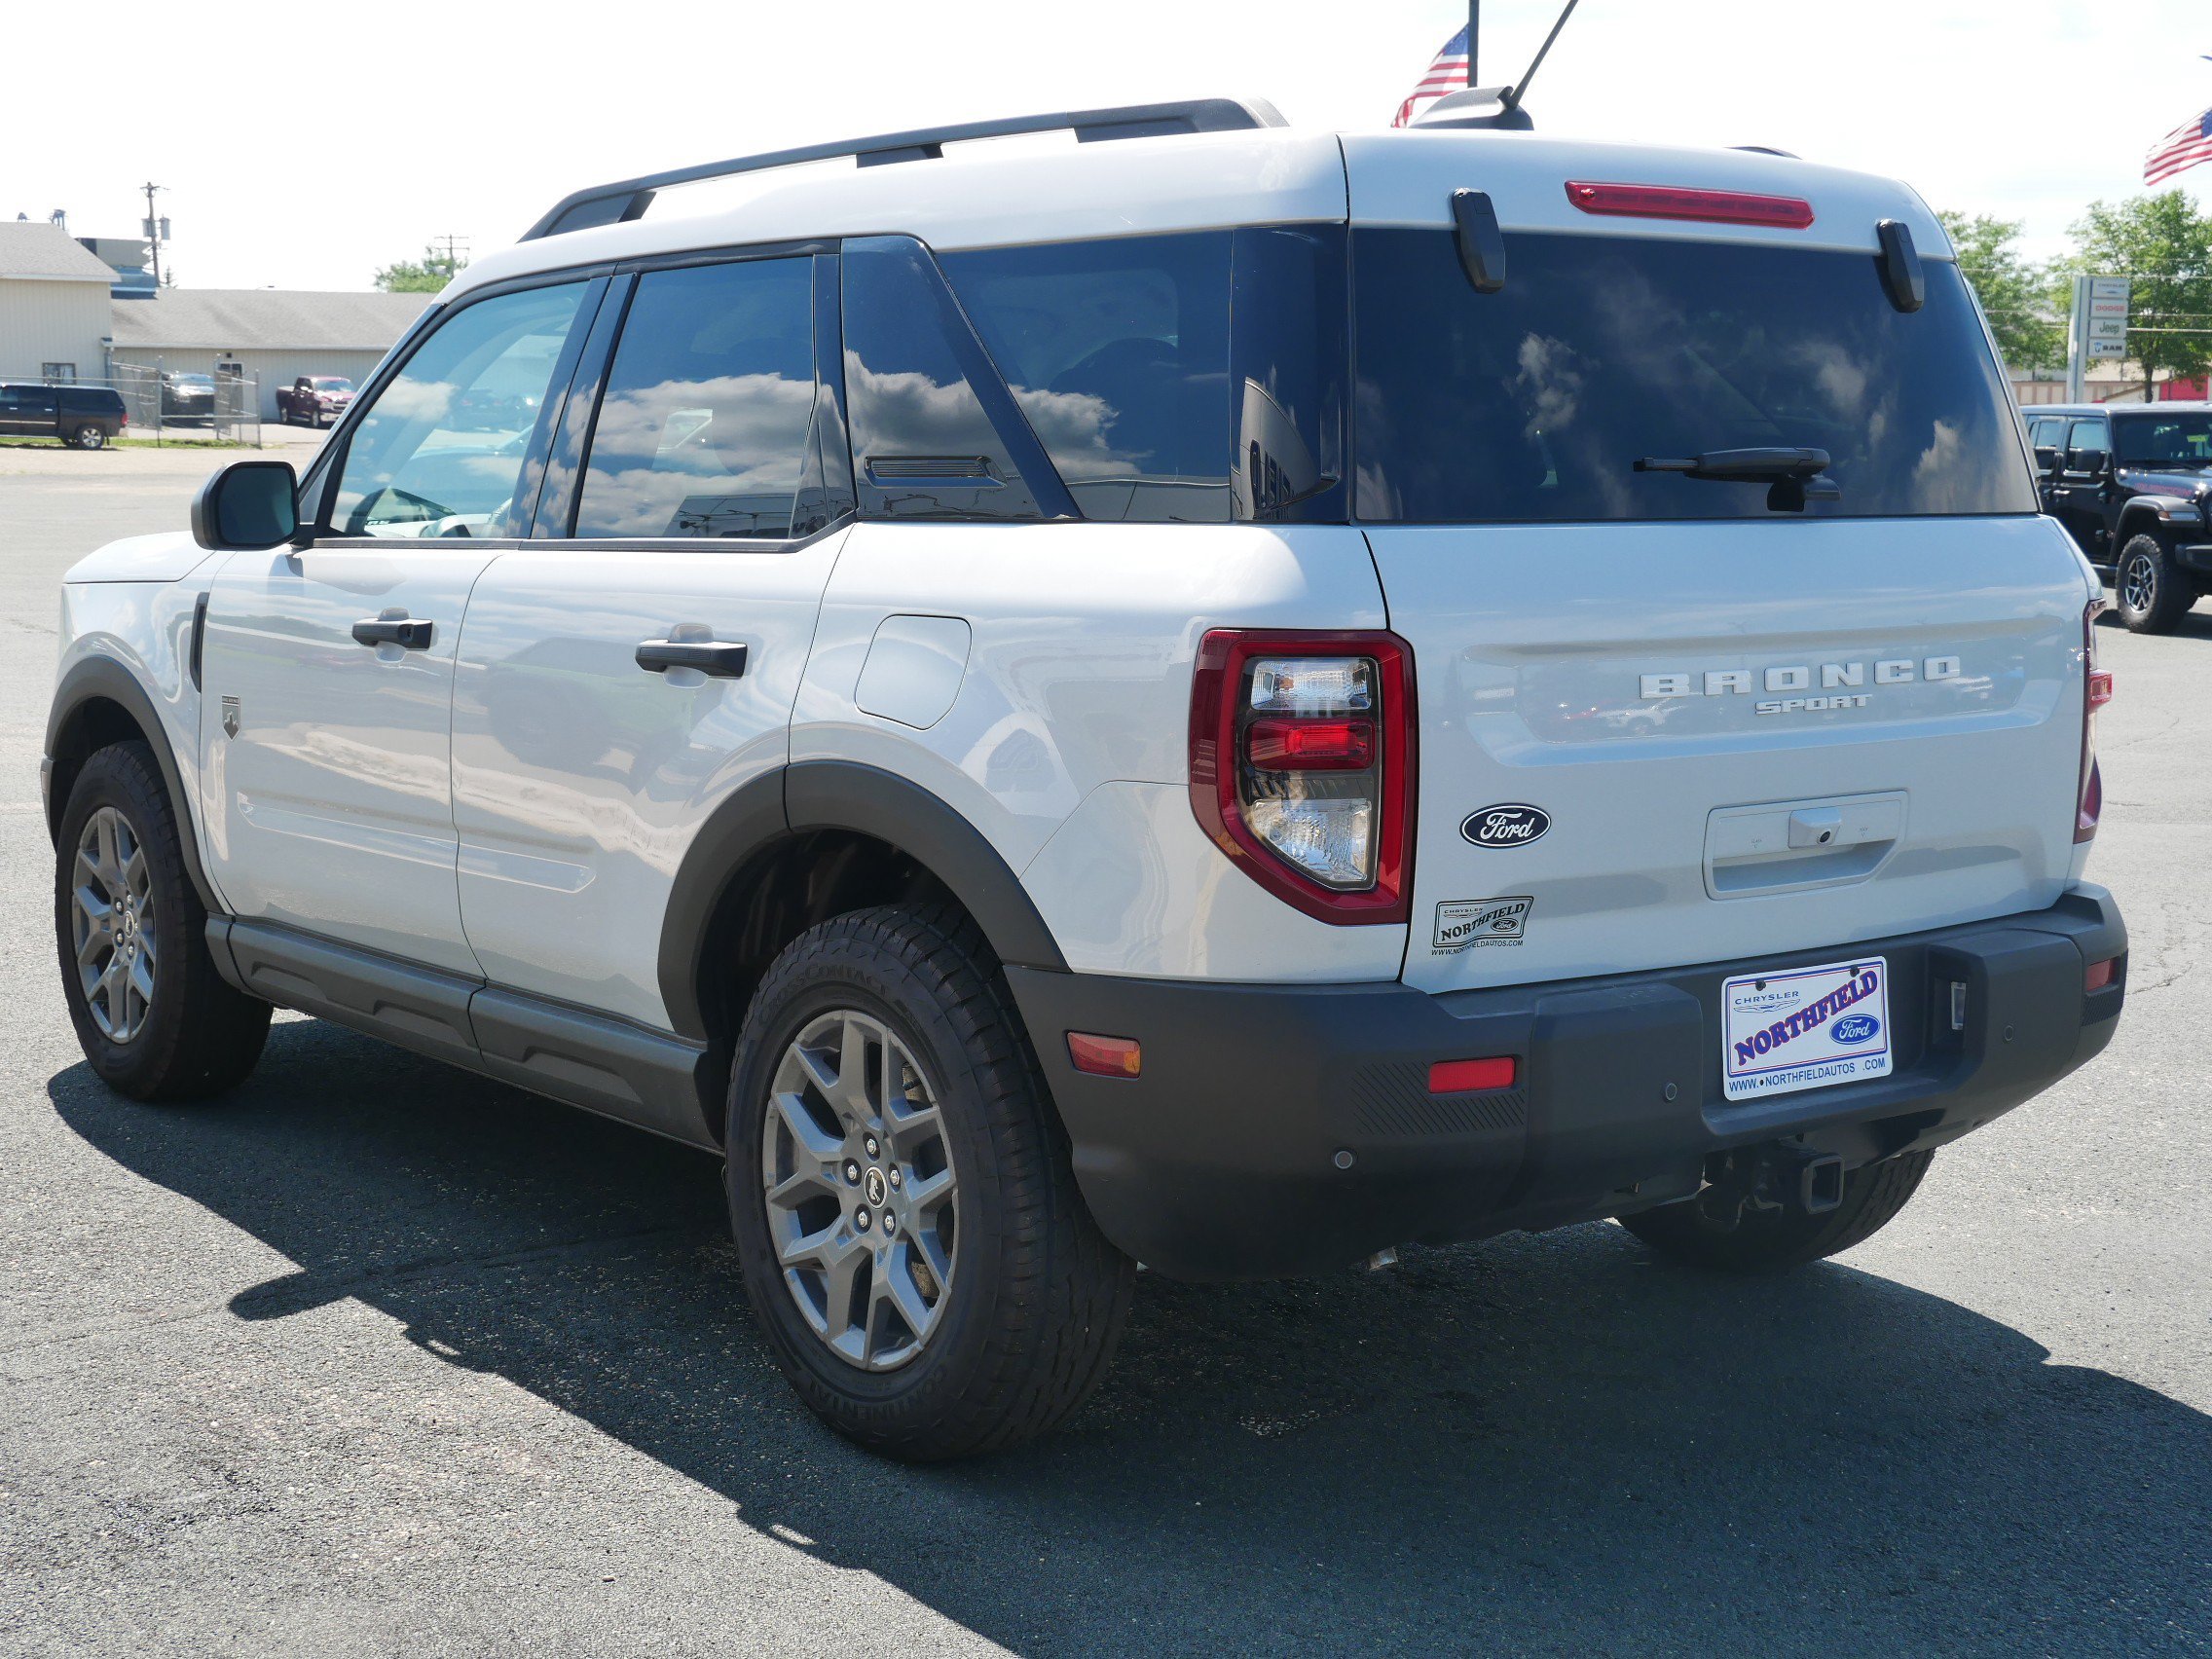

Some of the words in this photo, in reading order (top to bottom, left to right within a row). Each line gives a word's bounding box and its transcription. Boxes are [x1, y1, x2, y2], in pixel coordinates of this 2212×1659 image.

[2099, 321, 2120, 335] Jeep
[1640, 655, 1961, 699] BRONCO
[1754, 693, 1872, 716] SPORT
[1480, 812, 1535, 840] Ford
[1441, 903, 1526, 941] NORTHFIELD
[1734, 990, 1800, 1005] CHRYSLER
[1734, 971, 1879, 1066] NORTHFIELD
[1839, 1018, 1870, 1040] Ford
